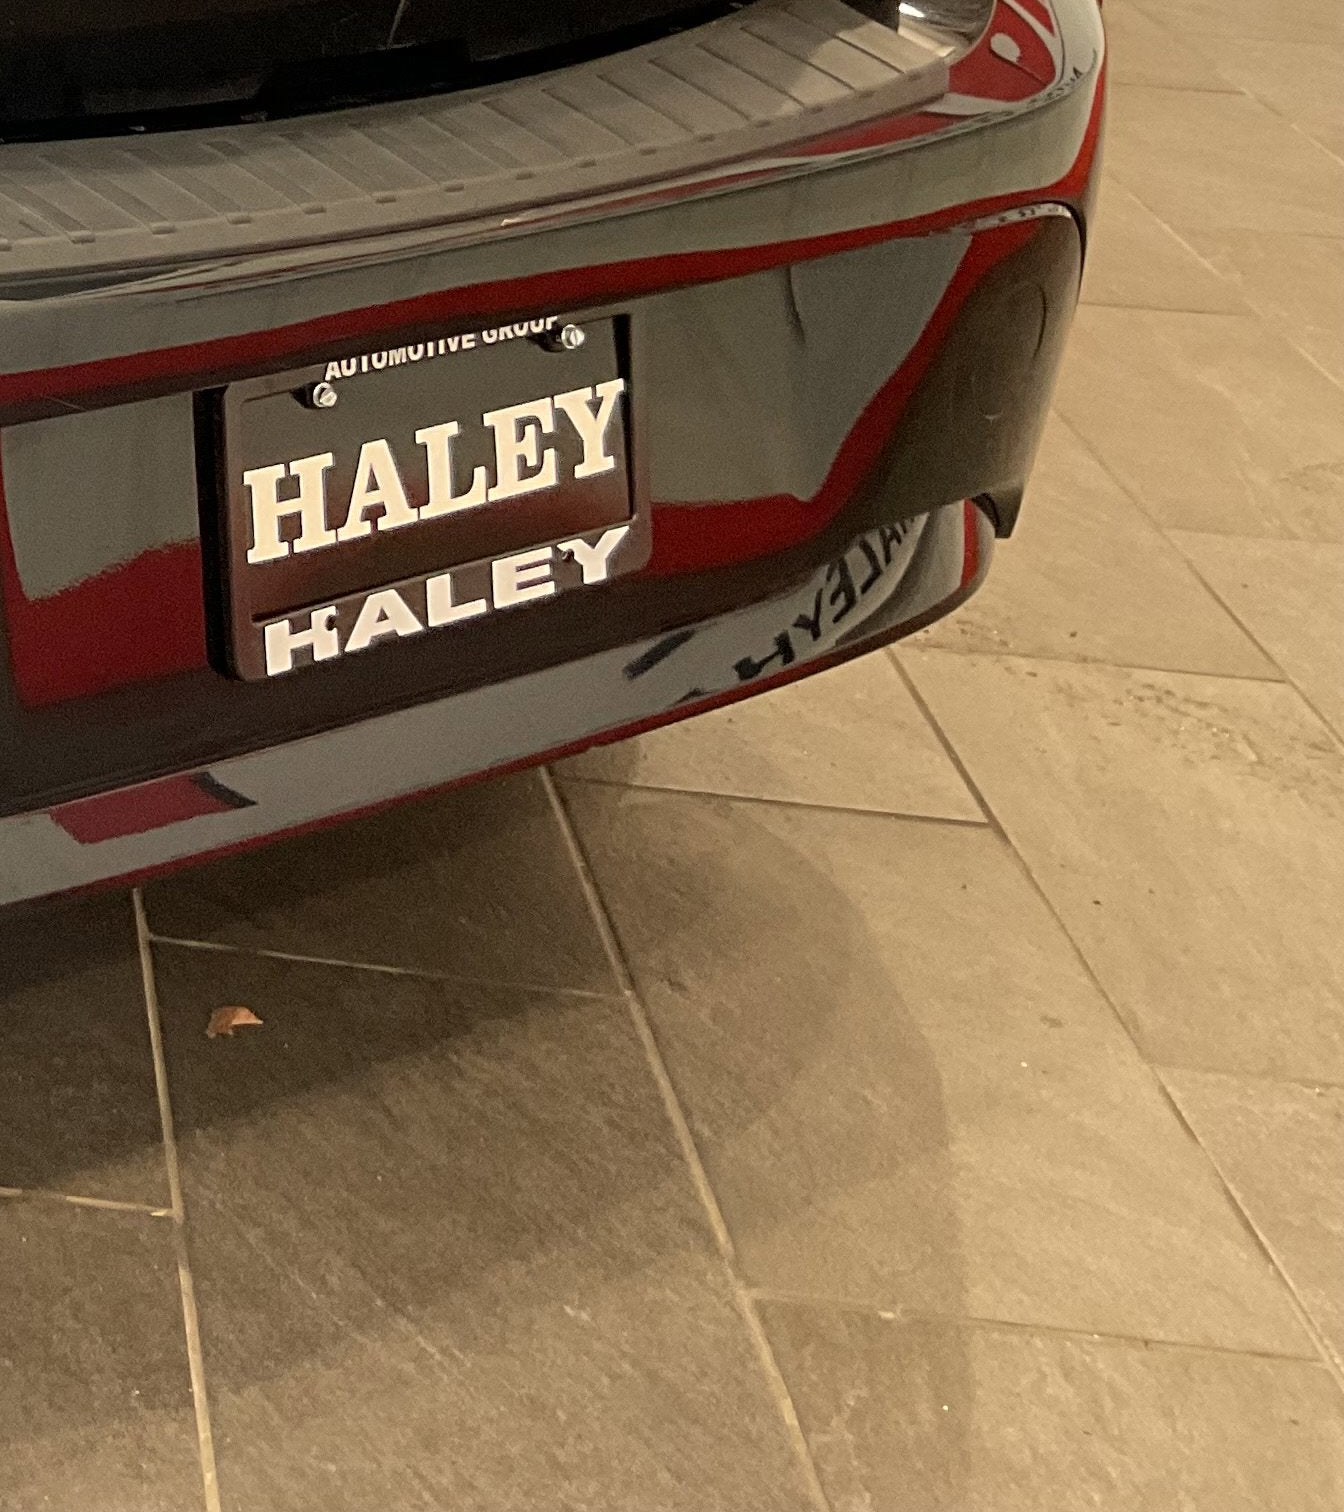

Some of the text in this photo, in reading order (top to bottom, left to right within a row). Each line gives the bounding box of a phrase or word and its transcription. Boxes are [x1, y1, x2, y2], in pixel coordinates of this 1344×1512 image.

[324, 332, 476, 381] AUTOMOTIVE
[243, 377, 626, 565] HALEY
[264, 524, 631, 678] HALEY
